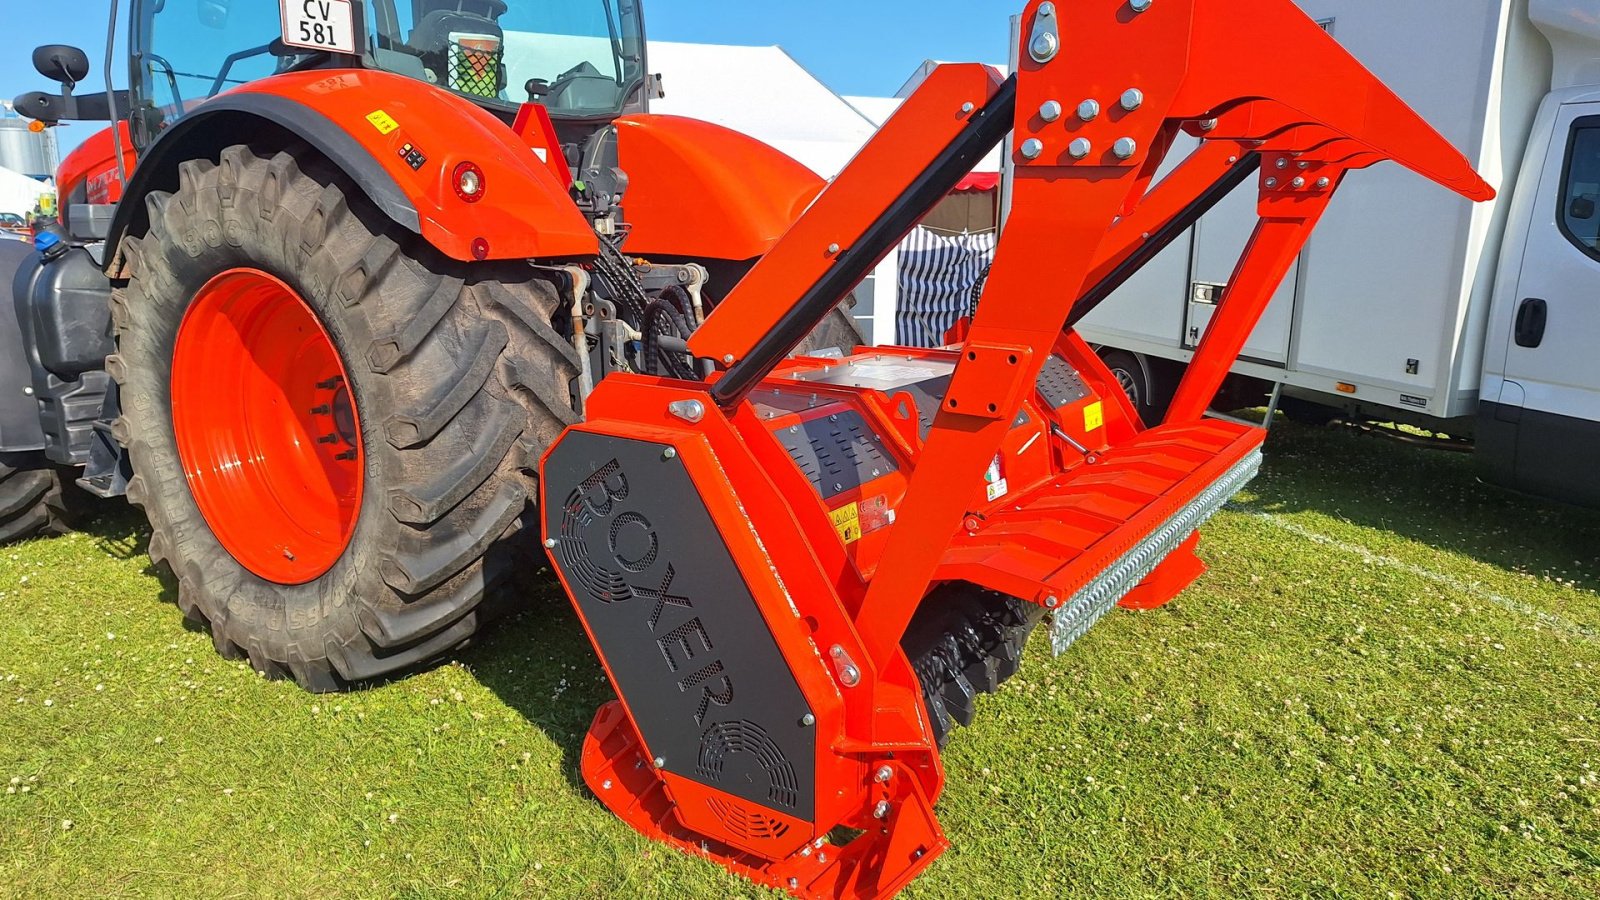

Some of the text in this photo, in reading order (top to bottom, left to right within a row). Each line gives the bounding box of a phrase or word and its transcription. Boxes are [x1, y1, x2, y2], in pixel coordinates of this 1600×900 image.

[303, 0, 330, 21] CV
[299, 20, 337, 46] 581
[577, 457, 734, 727] BOXER
